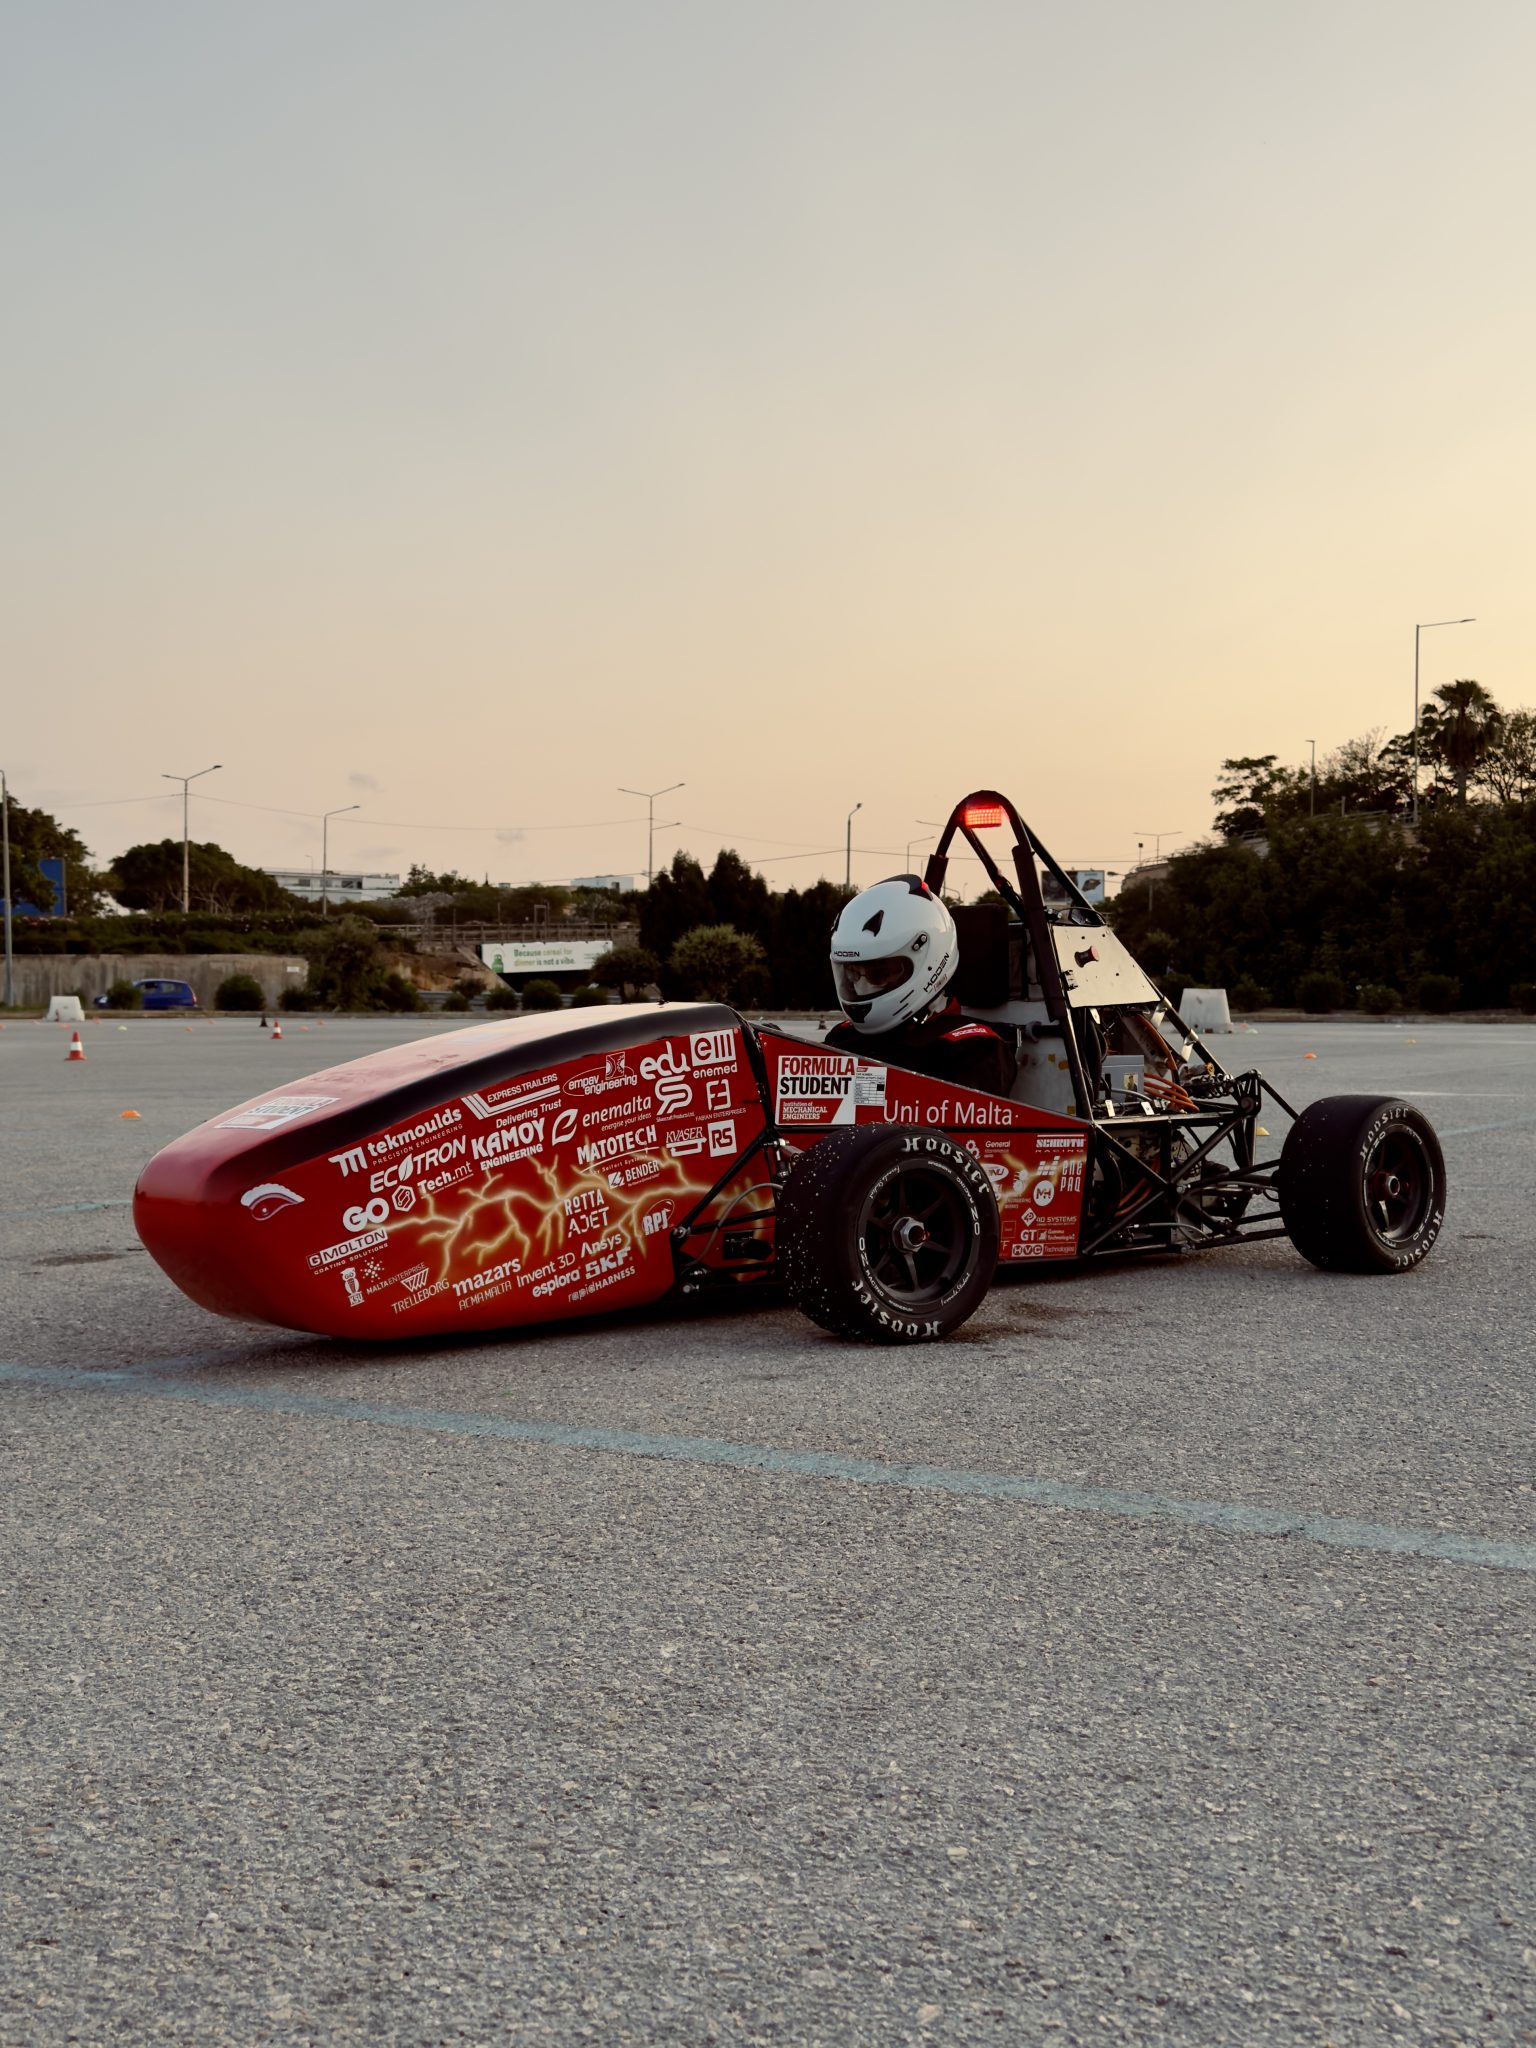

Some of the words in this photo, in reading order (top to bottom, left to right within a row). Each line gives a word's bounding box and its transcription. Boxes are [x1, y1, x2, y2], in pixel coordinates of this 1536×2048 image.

[543, 958, 554, 966] not
[640, 1041, 691, 1080] edu
[693, 1062, 738, 1079] enemed
[781, 1057, 855, 1076] FORMULA
[487, 1085, 522, 1103] EXPRESS
[522, 1074, 558, 1092] TRAILERS
[568, 1074, 600, 1090] empav
[584, 1074, 637, 1095] engineering
[780, 1077, 852, 1095] STUDENT
[496, 1108, 538, 1128] Delivering
[540, 1099, 562, 1113] Trust
[582, 1095, 652, 1127] enemalta
[624, 1117, 637, 1126] your
[638, 1112, 652, 1121] ideas
[783, 1106, 828, 1114] MECHANICAL
[884, 1100, 920, 1123] Uni
[926, 1100, 950, 1124] of
[955, 1100, 1012, 1126] Malta
[368, 1108, 462, 1156] tekmoulds
[372, 1146, 414, 1166] PRECISION
[416, 1124, 463, 1147] ENGINEERING
[471, 1117, 545, 1160] KAMOY
[576, 1124, 658, 1165] MATOTECH
[666, 1126, 704, 1143] KVASER
[712, 1127, 733, 1150] RS
[986, 1140, 1011, 1148] General
[1036, 1138, 1085, 1148] SCHROTH
[480, 1144, 544, 1171] ENGINEERING
[625, 1160, 660, 1182] BENDER
[417, 1161, 472, 1194] Tech.mt
[342, 1198, 390, 1232] GO
[564, 1188, 605, 1216] ROTTA
[568, 1206, 610, 1238] AJET
[1021, 1230, 1037, 1240] GT
[323, 1229, 386, 1260] MOLTON
[581, 1234, 622, 1258] Ansys
[1012, 1245, 1042, 1256] HVC
[314, 1260, 346, 1275] COATING
[350, 1242, 389, 1261] SOLUTIONS
[516, 1262, 556, 1288] Invent
[558, 1252, 576, 1270] 3D
[585, 1246, 631, 1280] SKF
[452, 1258, 521, 1297] mazars
[532, 1268, 580, 1298] esplora
[865, 1270, 885, 1297] RACING
[392, 1278, 450, 1314] TRELLEBORG
